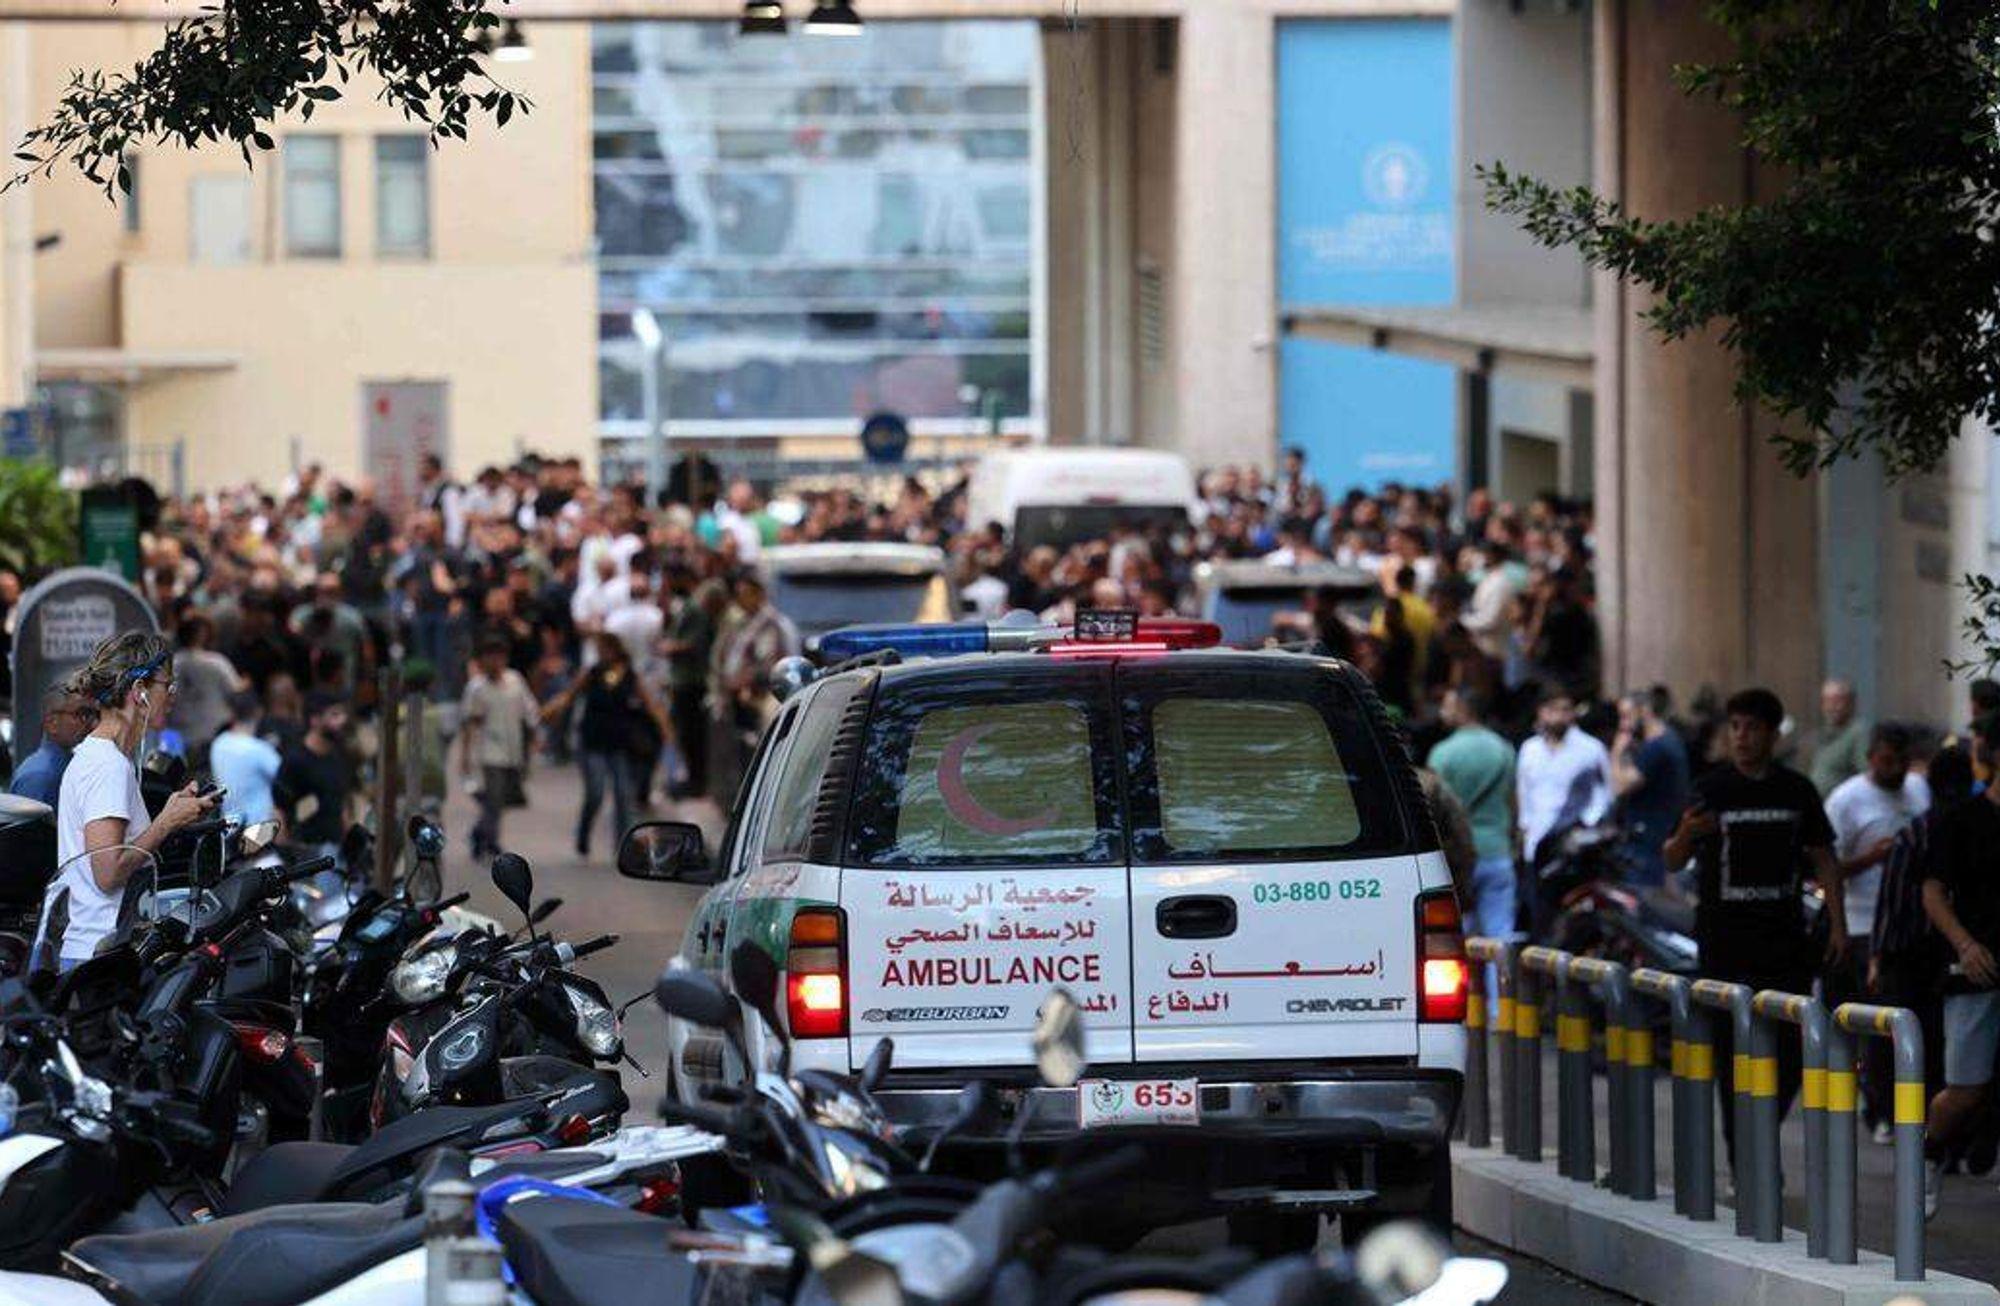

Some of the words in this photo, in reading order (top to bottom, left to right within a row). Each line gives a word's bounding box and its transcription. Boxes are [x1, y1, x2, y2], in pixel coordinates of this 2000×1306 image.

[1253, 881, 1331, 903] 03-880
[1339, 879, 1381, 899] 052
[885, 922, 978, 954] الصحي
[881, 954, 1100, 987] AMBULANCE
[886, 1005, 1010, 1021] SUBURBAN
[1148, 990, 1230, 1019] الدفاع
[1286, 998, 1406, 1013] CHEVROLET
